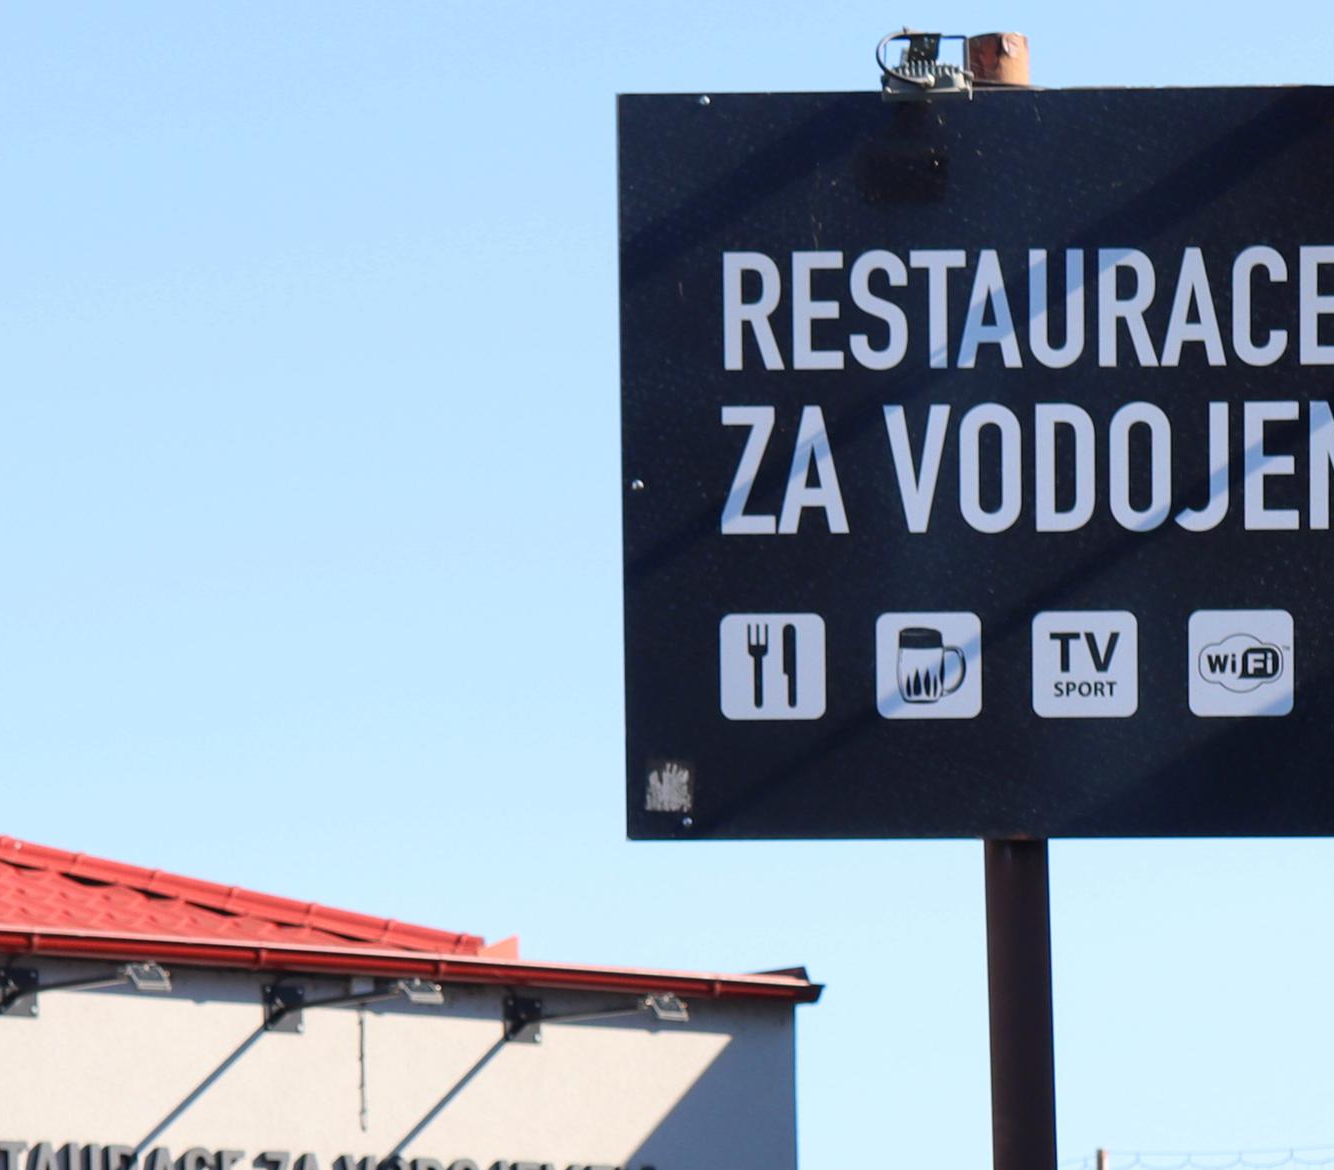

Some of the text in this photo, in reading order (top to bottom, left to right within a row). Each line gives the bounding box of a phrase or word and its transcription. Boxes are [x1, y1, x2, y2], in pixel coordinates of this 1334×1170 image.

[720, 404, 851, 534] ZA
[1049, 631, 1120, 674] TV
[1206, 652, 1276, 675] WiFi
[1053, 681, 1118, 698] SPORT
